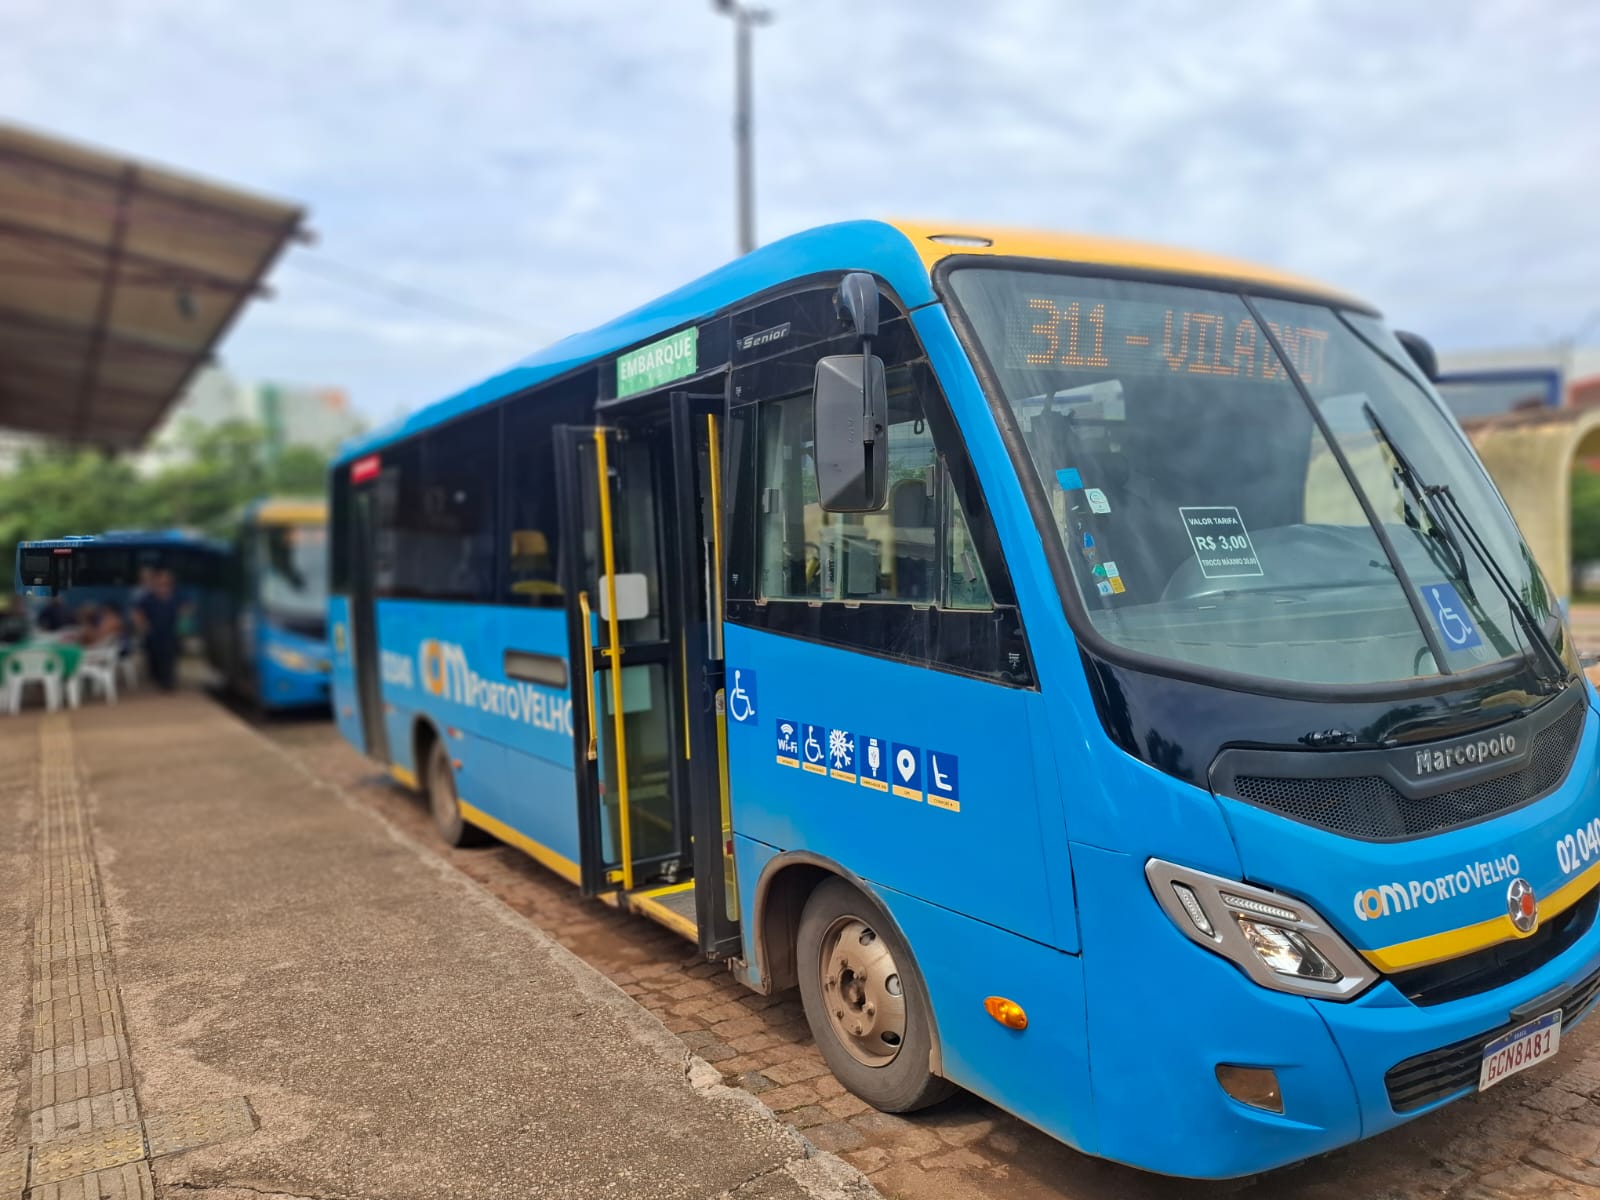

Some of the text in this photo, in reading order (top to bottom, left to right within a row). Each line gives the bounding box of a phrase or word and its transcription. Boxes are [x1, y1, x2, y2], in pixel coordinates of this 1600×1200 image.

[743, 328, 788, 349] Senior
[1027, 299, 1109, 367] 311
[1163, 310, 1257, 378] VILA
[620, 337, 691, 380] EMBARQUE
[1213, 517, 1238, 525] TARIFA
[1195, 535, 1247, 551] R$ 3,00
[777, 738, 798, 754] Wi-Fi
[1415, 733, 1515, 776] Marcopolo
[1488, 1029, 1551, 1081] GCN8A81
